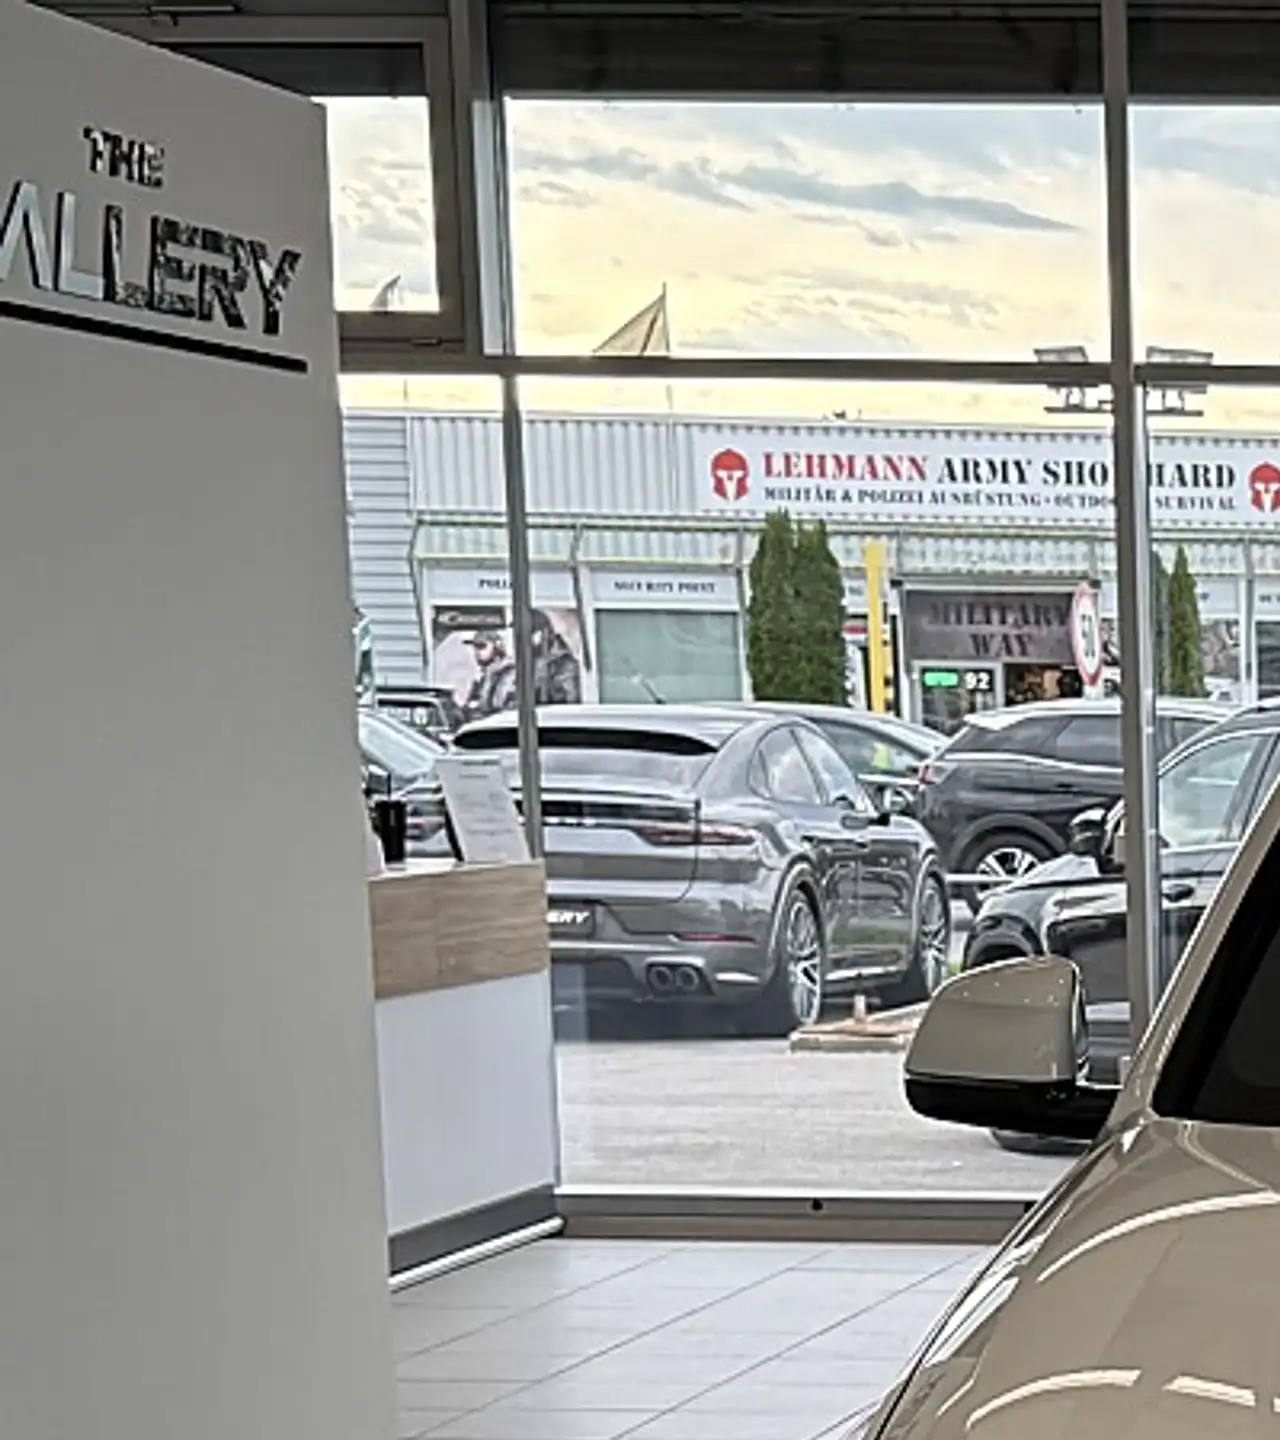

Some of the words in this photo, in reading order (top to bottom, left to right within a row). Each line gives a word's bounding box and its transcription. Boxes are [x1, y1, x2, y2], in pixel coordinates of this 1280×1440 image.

[83, 126, 164, 188] THE
[0, 178, 302, 336] ALLERY
[764, 452, 928, 482] LEHMANN
[937, 458, 1031, 486] ARMY
[1042, 461, 1110, 488] SHO
[1053, 493, 1115, 509] OUTDO
[1154, 495, 1236, 510] SURVIVAL
[969, 633, 1030, 657] WAY
